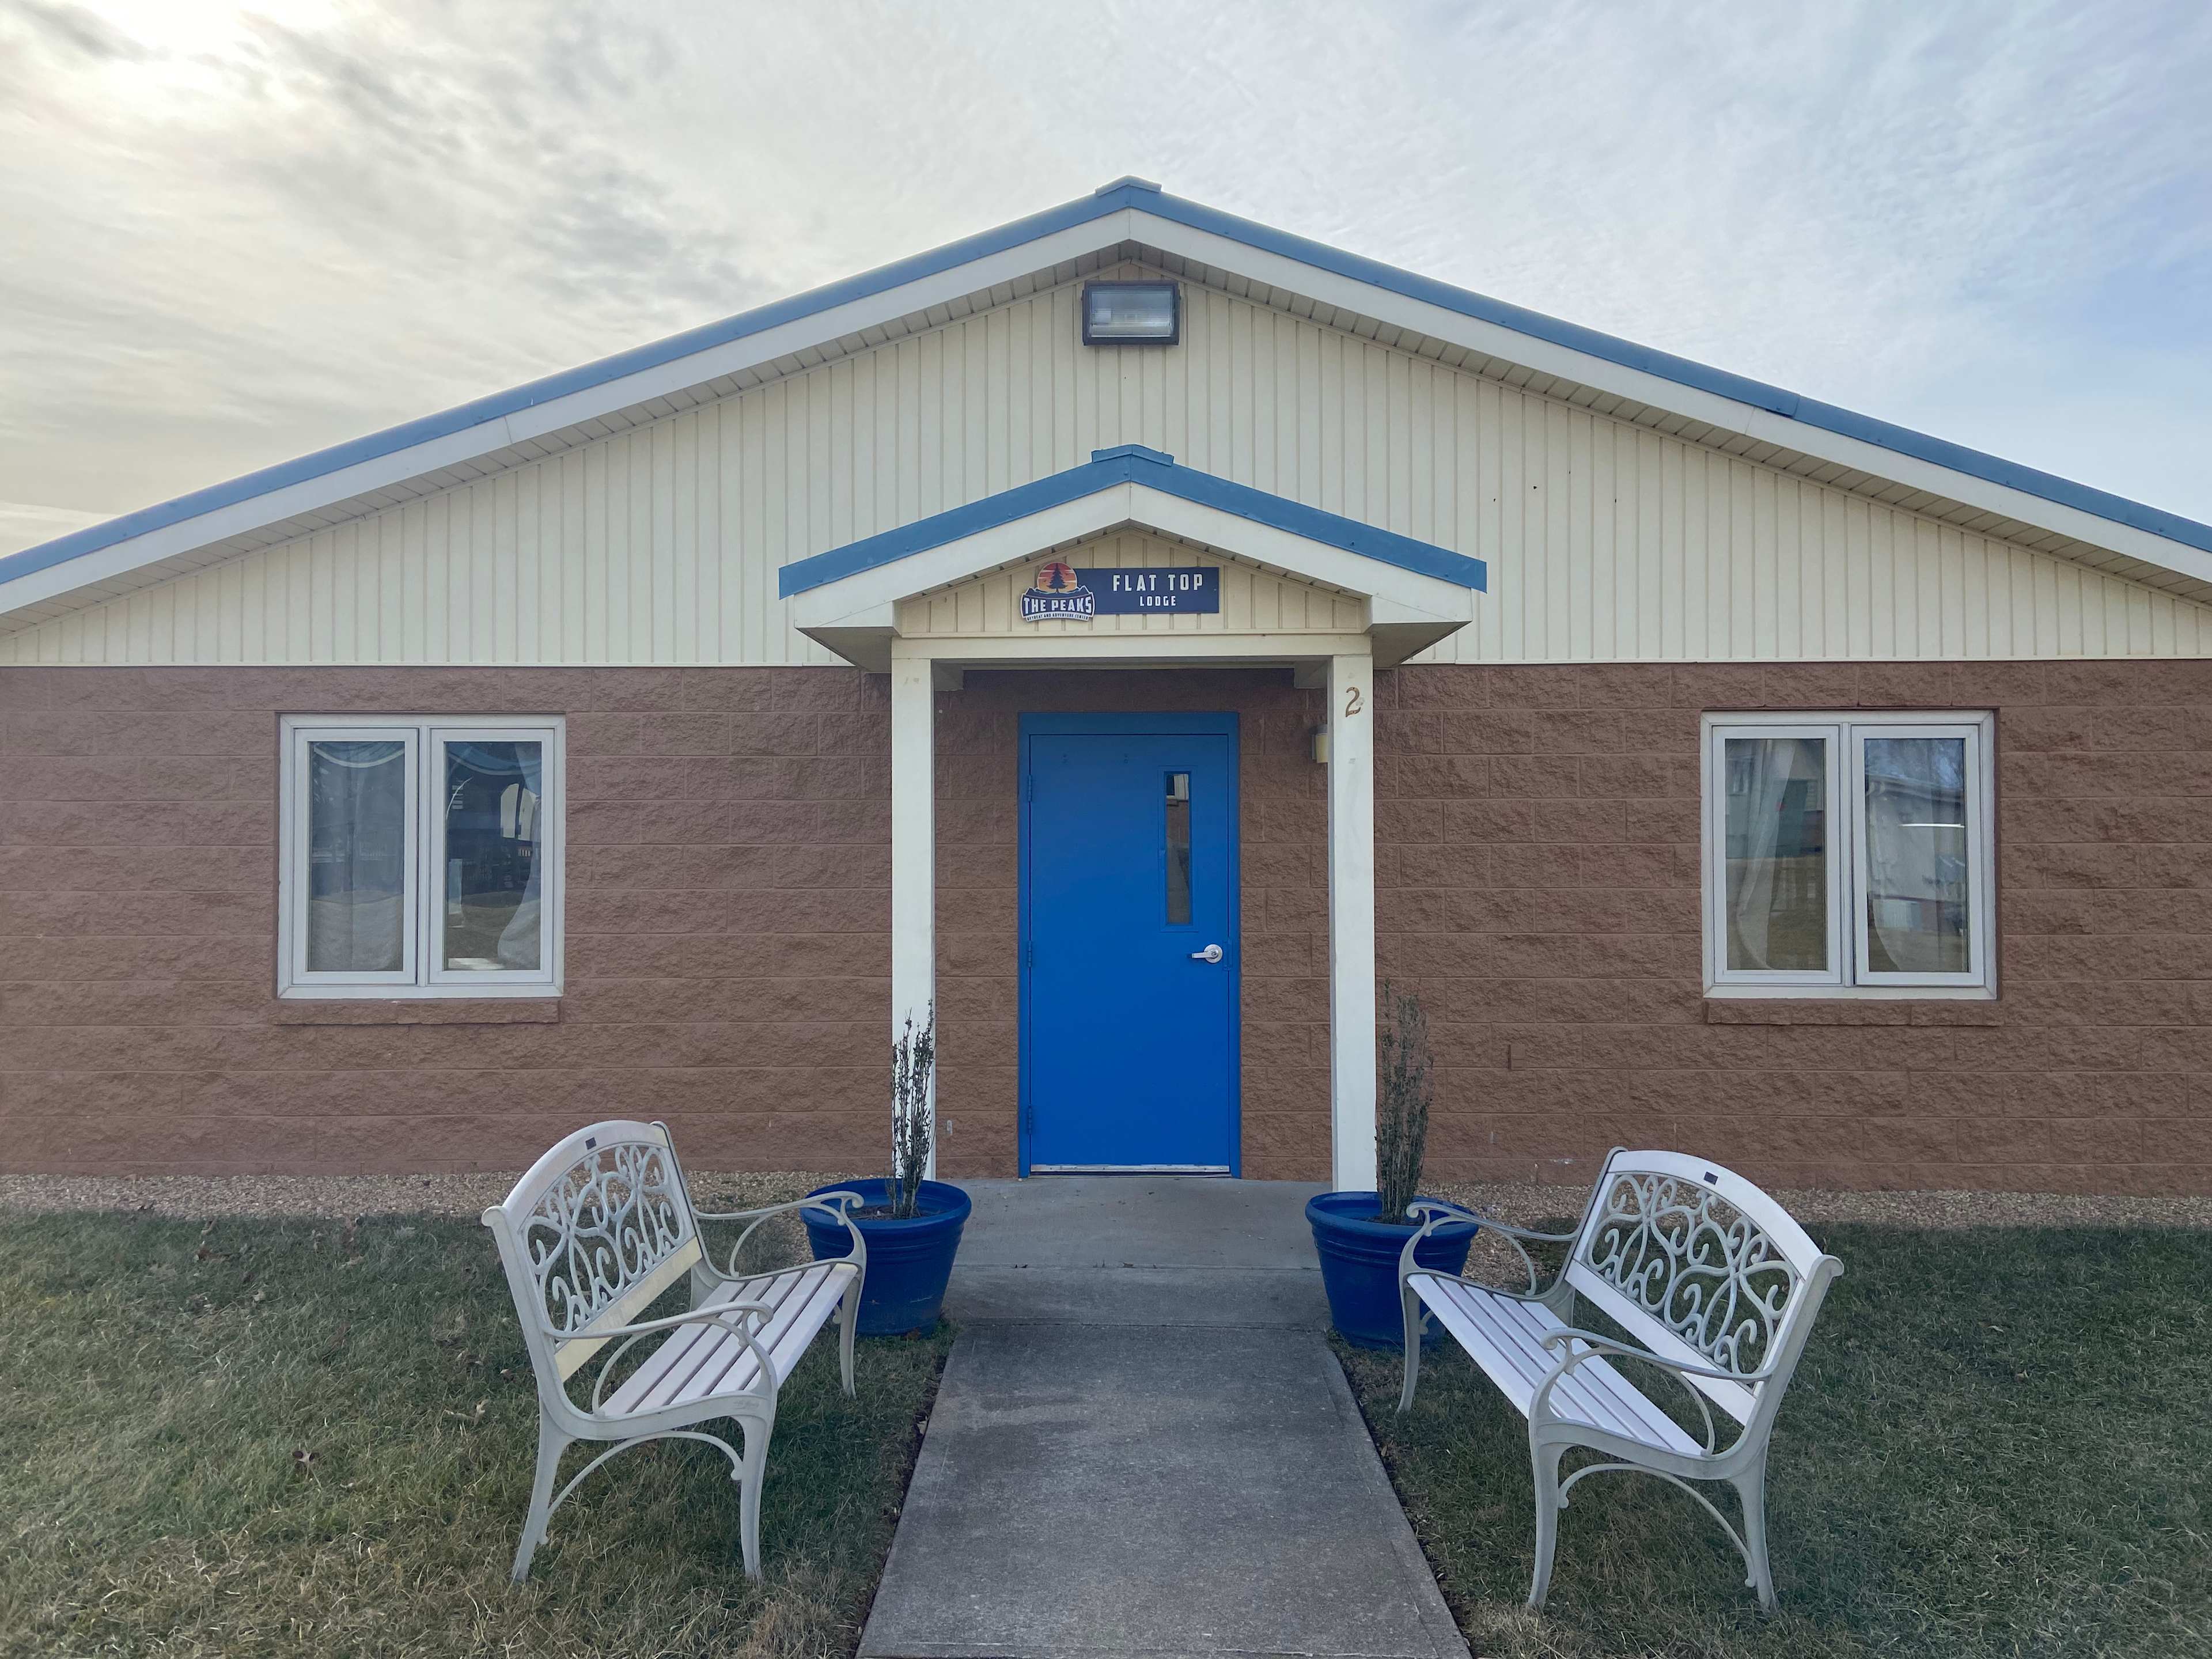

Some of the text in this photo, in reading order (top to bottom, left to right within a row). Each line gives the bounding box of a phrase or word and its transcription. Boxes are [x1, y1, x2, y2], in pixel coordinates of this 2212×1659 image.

[1113, 574, 1203, 591] FLAT TOP
[1024, 596, 1092, 615] THE PEAKS
[1139, 596, 1176, 607] LODGE
[1346, 687, 1361, 718] 2
